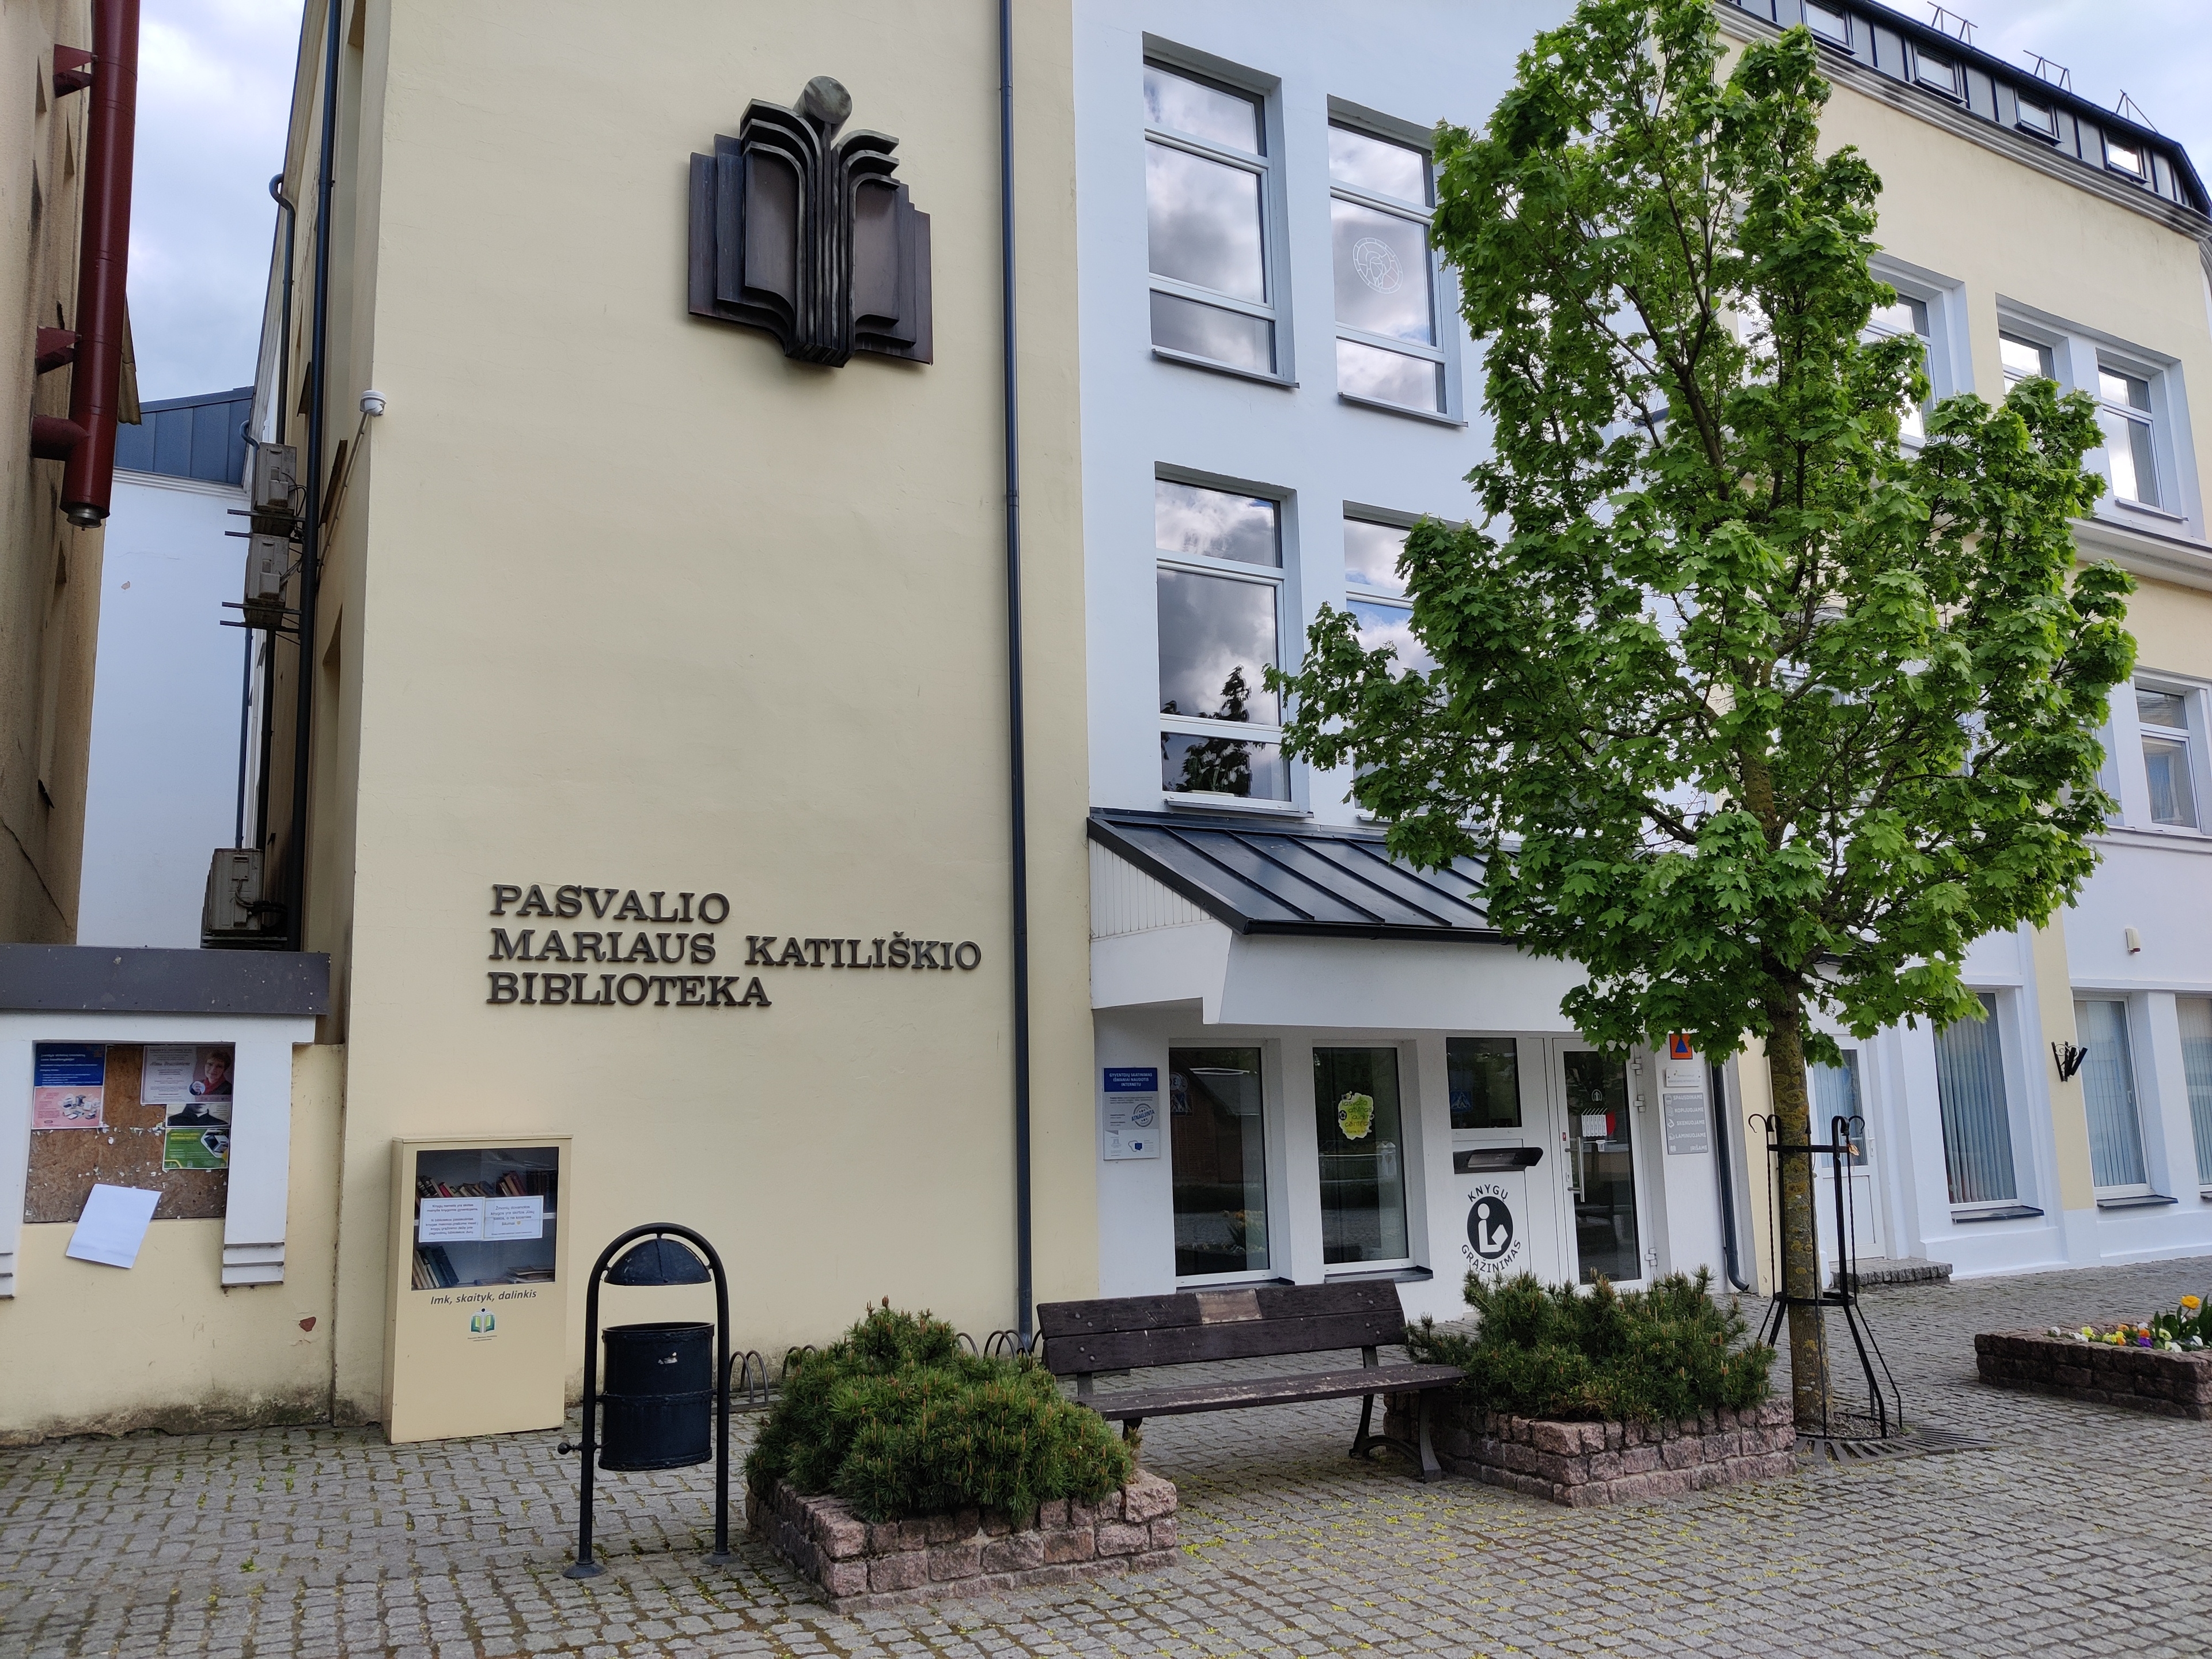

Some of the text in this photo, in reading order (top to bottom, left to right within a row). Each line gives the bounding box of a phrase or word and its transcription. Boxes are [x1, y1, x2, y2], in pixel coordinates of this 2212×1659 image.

[490, 884, 730, 923] PASVALIO
[488, 928, 982, 970] MARIAUS KATILIŠKIO
[487, 972, 772, 1006] BIBLIOTEKA
[1131, 1109, 1155, 1122] ATNAUJINTA
[1468, 1184, 1508, 1202] KNYGŲ
[1461, 1240, 1521, 1273] GRĄŽINIMAS
[431, 1289, 537, 1305] Imk, skaityk, dalinkis
